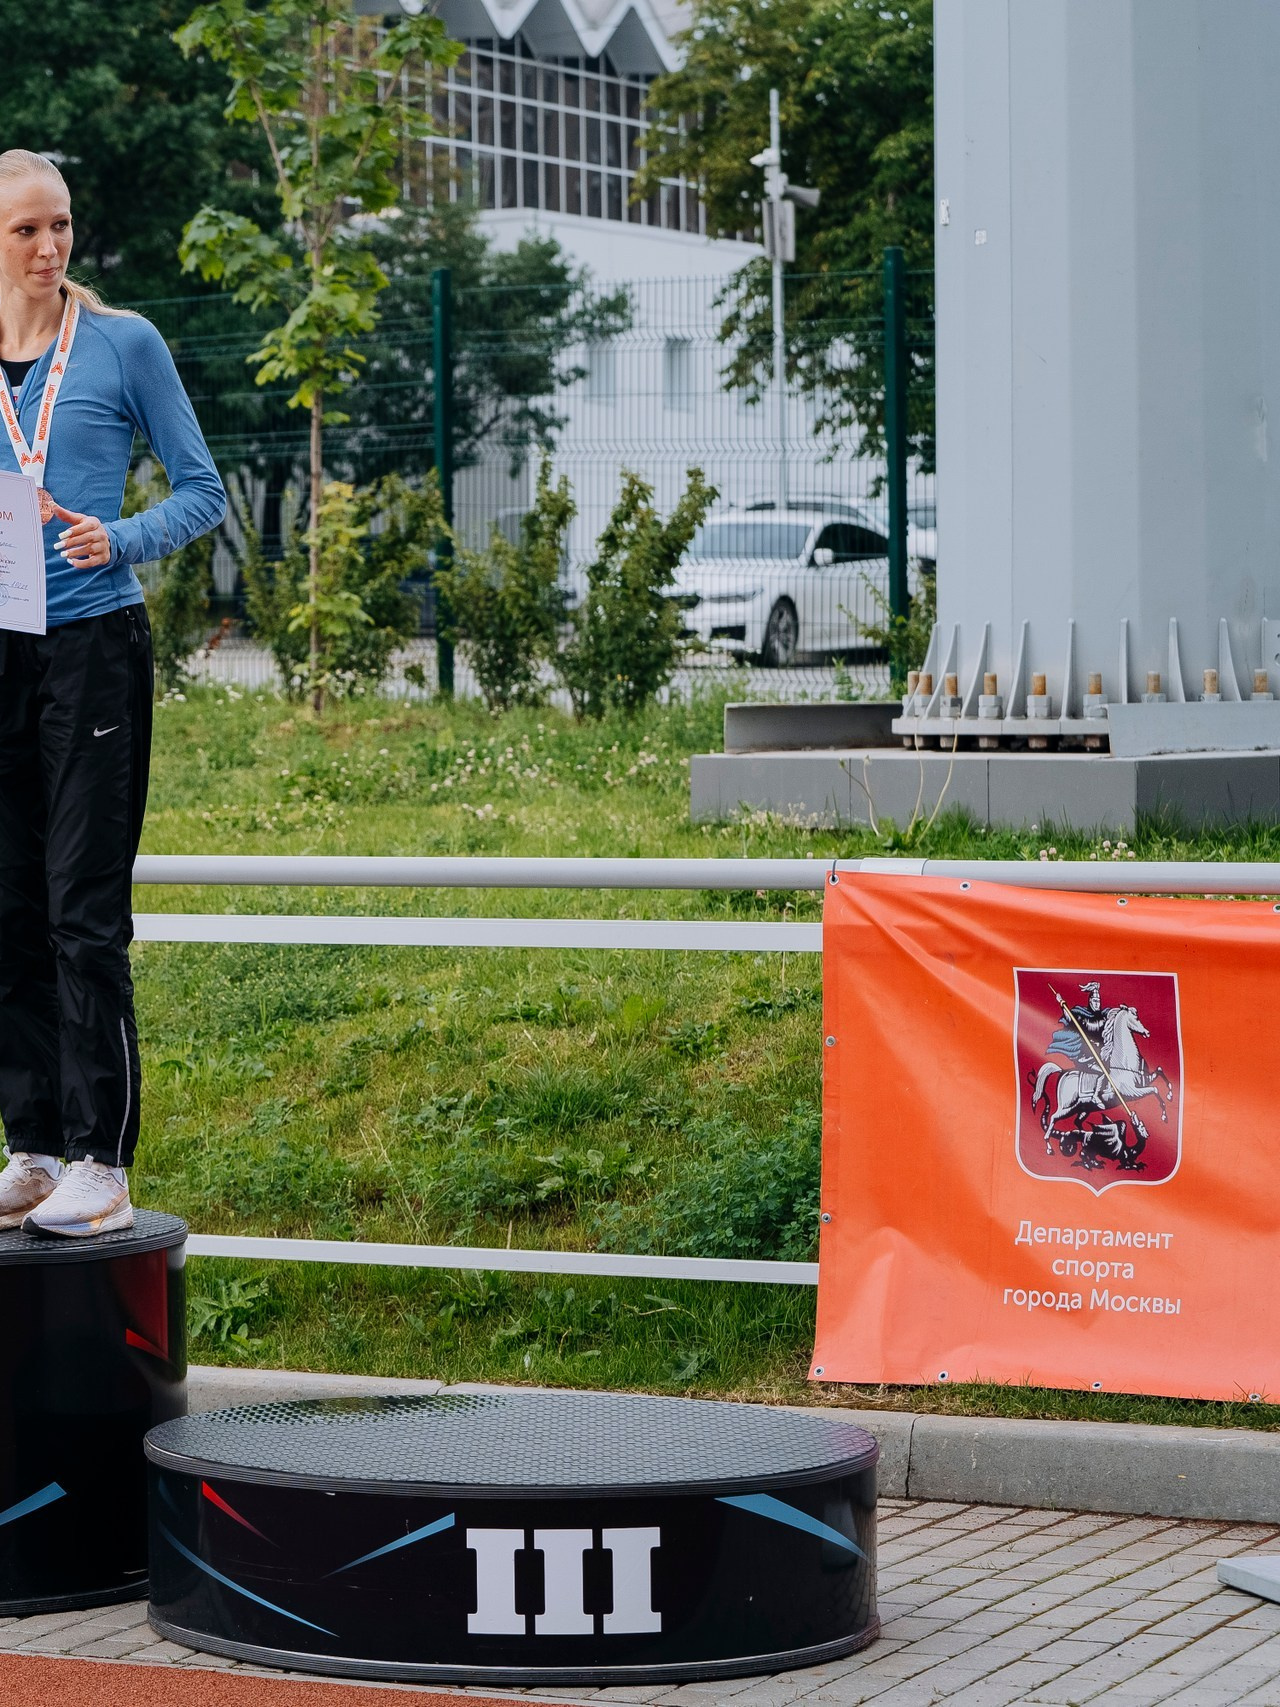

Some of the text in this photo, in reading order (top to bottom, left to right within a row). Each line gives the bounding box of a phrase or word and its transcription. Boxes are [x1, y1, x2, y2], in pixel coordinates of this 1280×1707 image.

[38, 384, 56, 441] МОСКОВСКИЙ СПОРТ
[10, 426, 22, 443] СПОРТ
[1014, 1220, 1174, 1251] Департамент
[1052, 1258, 1135, 1283] спорта
[1003, 1288, 1181, 1315] города Москвы
[466, 1526, 661, 1635] III
